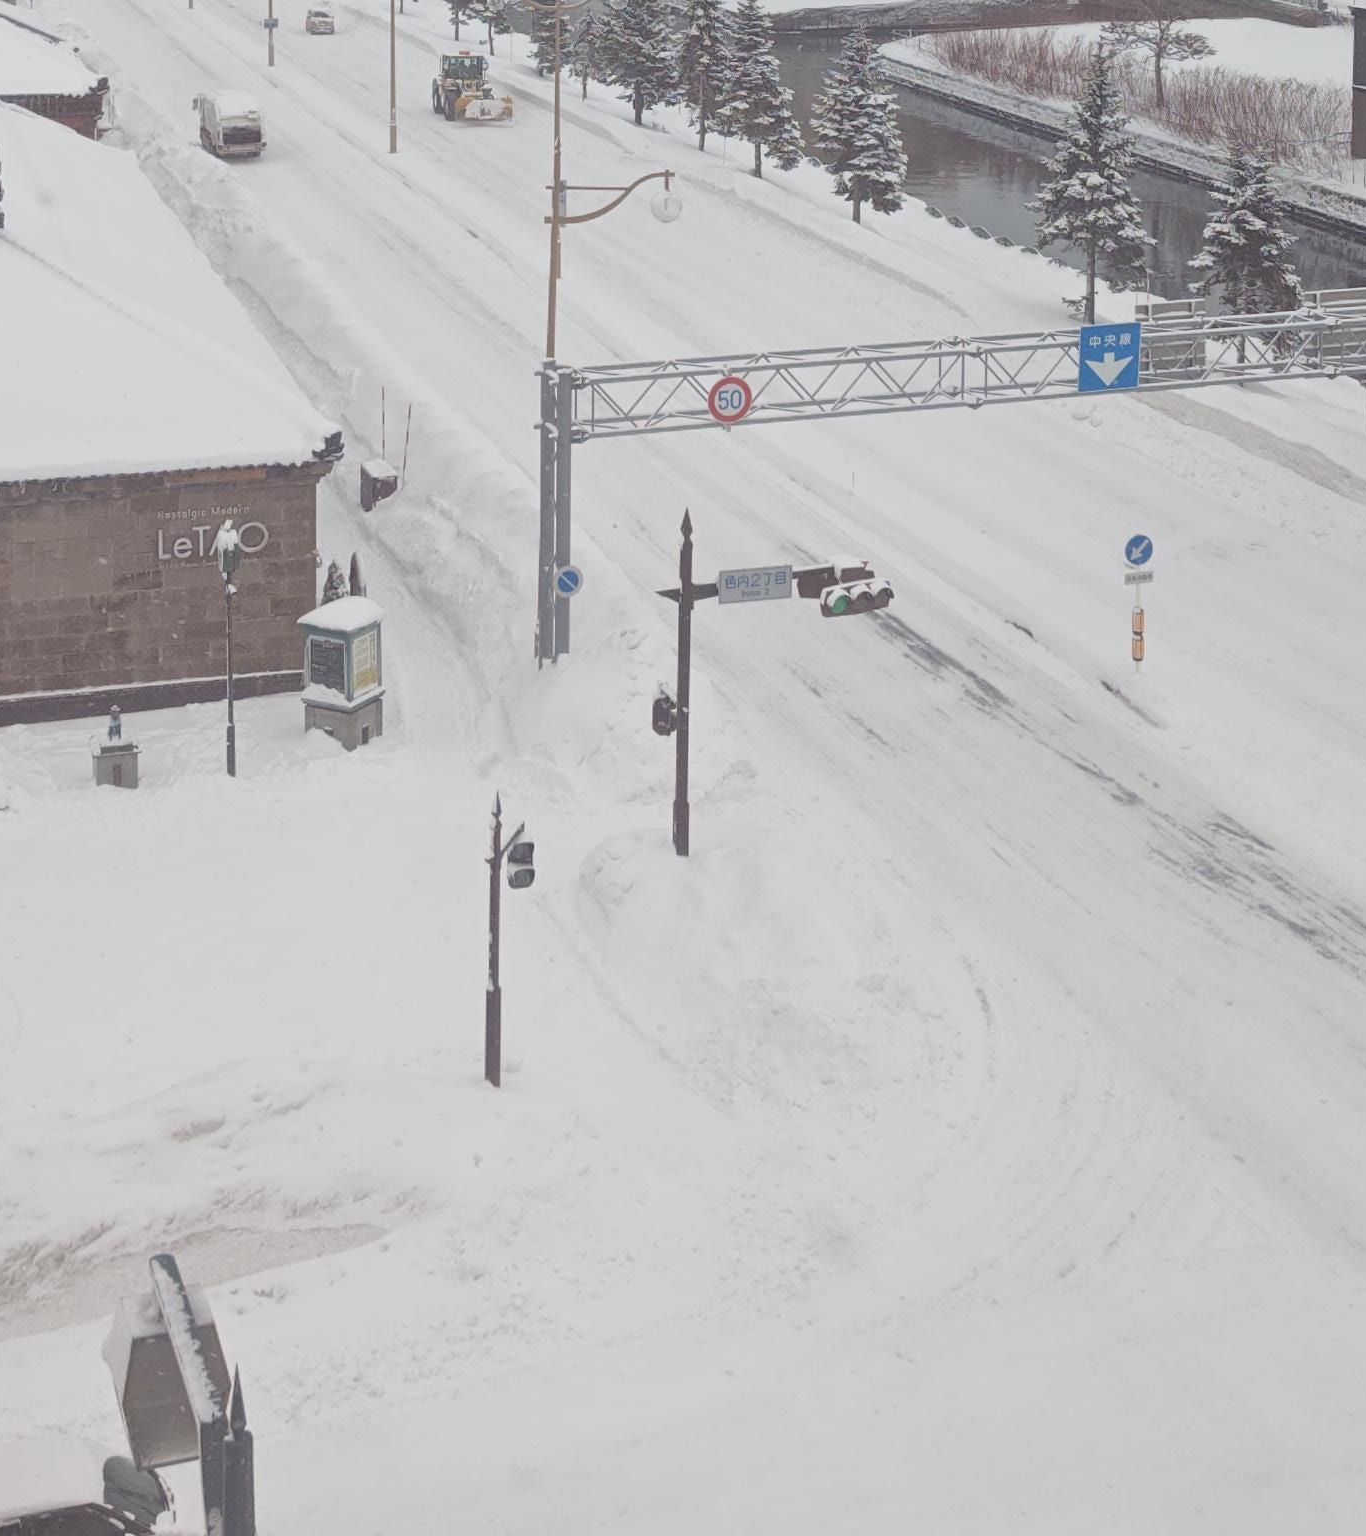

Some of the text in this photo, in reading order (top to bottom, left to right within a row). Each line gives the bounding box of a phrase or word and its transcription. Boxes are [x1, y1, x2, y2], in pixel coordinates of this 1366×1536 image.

[1088, 332, 1132, 348] 中央線
[718, 389, 742, 410] 50
[157, 505, 251, 520] Nostalgic Modern
